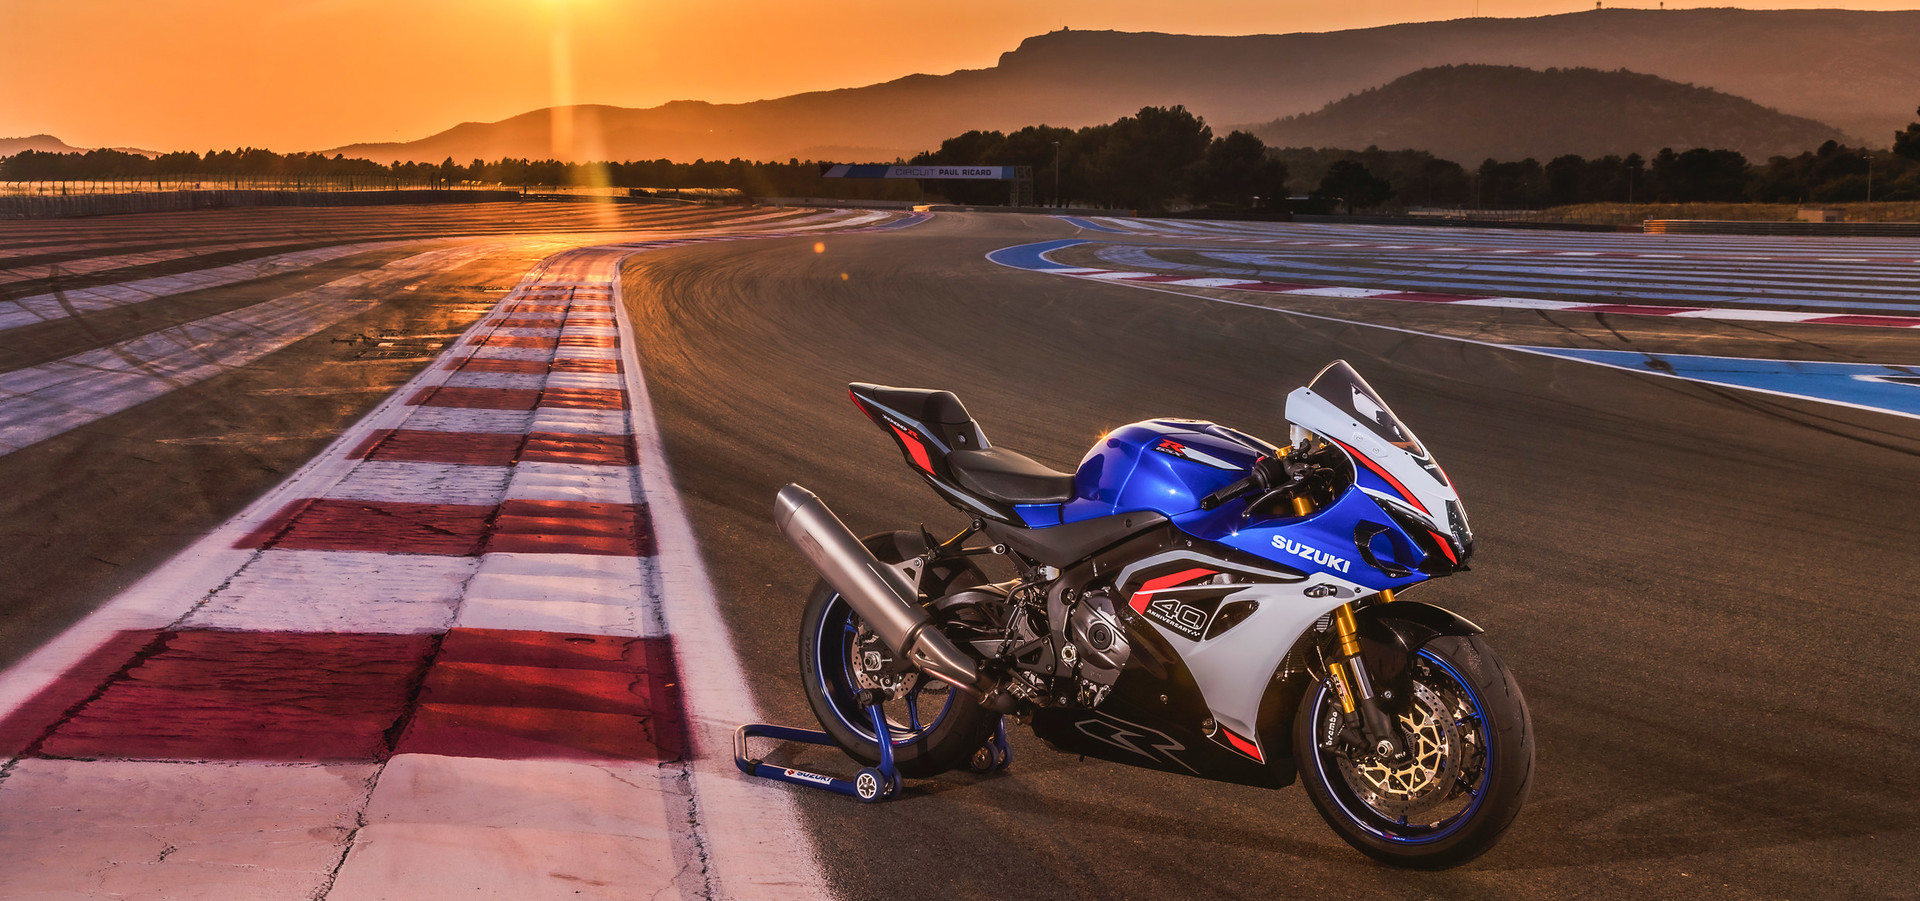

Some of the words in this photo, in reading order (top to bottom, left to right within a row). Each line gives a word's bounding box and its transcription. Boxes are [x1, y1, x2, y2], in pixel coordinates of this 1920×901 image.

[895, 168, 935, 176] CIRCUIT
[938, 168, 959, 176] PAUL
[962, 168, 992, 176] RICARD
[1271, 534, 1351, 574] SUZUKI
[1146, 609, 1193, 634] ANNIVERSARY
[1152, 599, 1208, 630] 40
[1325, 711, 1338, 746] brembo
[796, 771, 832, 782] SUZUKI
